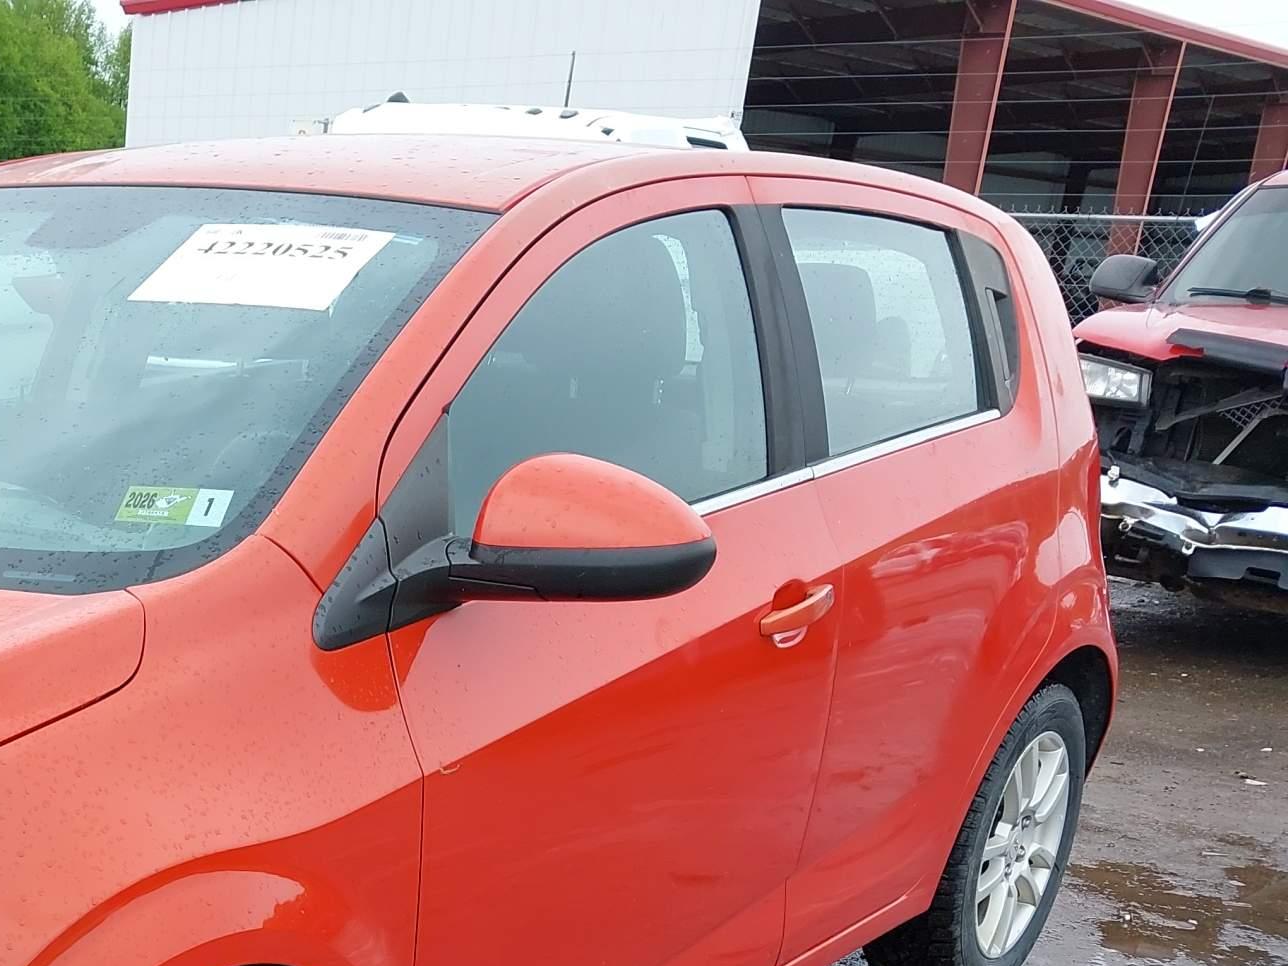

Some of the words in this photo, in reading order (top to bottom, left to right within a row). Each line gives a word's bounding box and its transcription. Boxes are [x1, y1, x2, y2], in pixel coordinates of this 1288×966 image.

[197, 240, 353, 260] 42220525
[125, 492, 158, 509] 2026
[203, 497, 215, 517] 1
